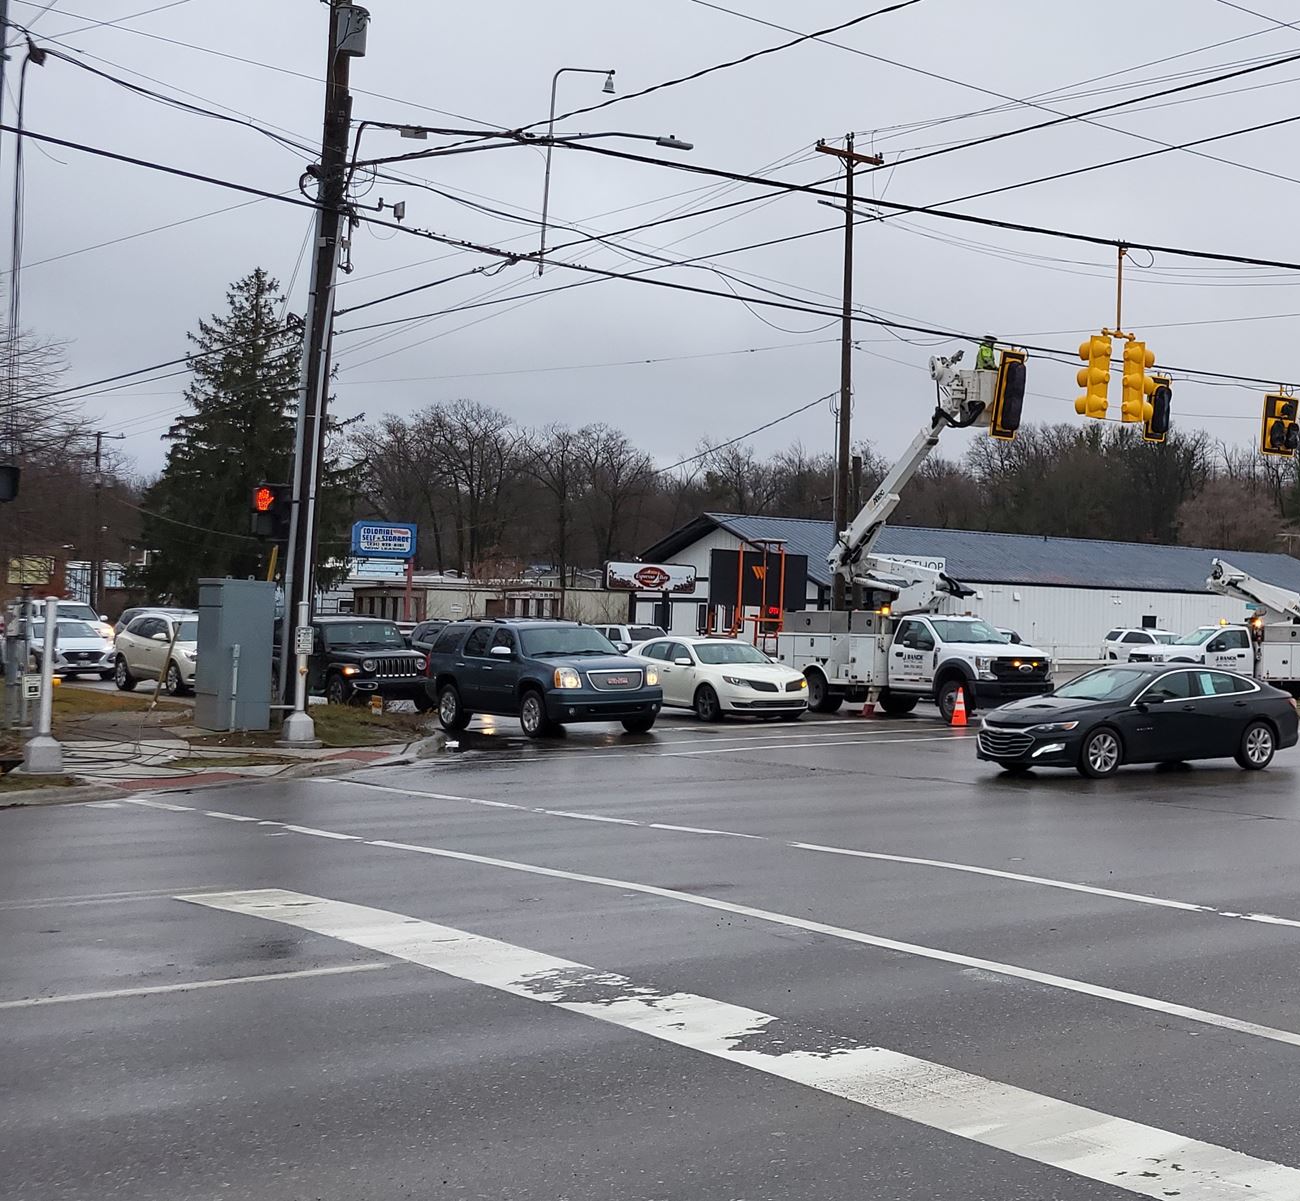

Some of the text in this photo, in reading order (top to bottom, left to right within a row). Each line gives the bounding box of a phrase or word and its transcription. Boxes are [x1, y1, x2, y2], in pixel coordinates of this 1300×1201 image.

[363, 528, 394, 536] COLONIAL
[362, 534, 409, 544] SELF STORAGE
